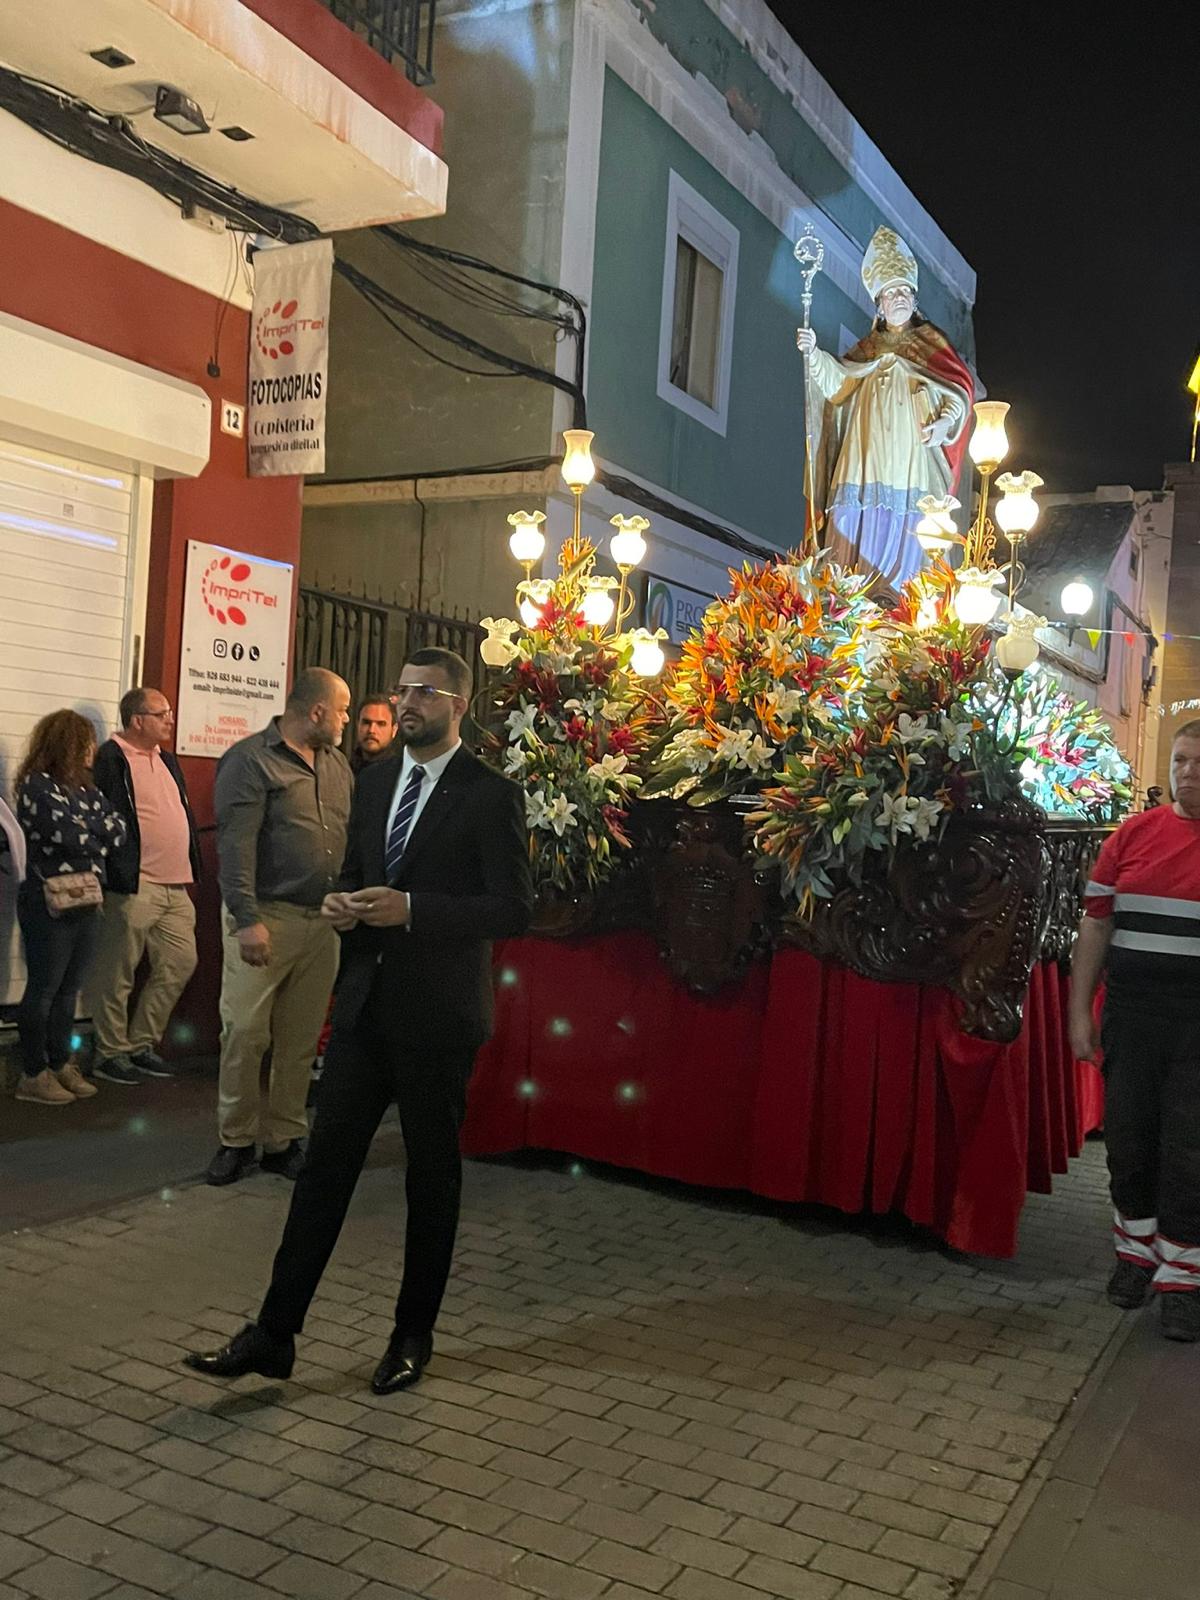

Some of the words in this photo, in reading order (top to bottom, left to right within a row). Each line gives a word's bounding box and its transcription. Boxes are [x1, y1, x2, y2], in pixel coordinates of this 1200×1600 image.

[263, 316, 325, 338] ImpriTel
[250, 372, 322, 407] FOTOCOPIAS
[225, 408, 240, 430] 12
[290, 438, 320, 452] digital
[209, 581, 278, 609] ImpriTel
